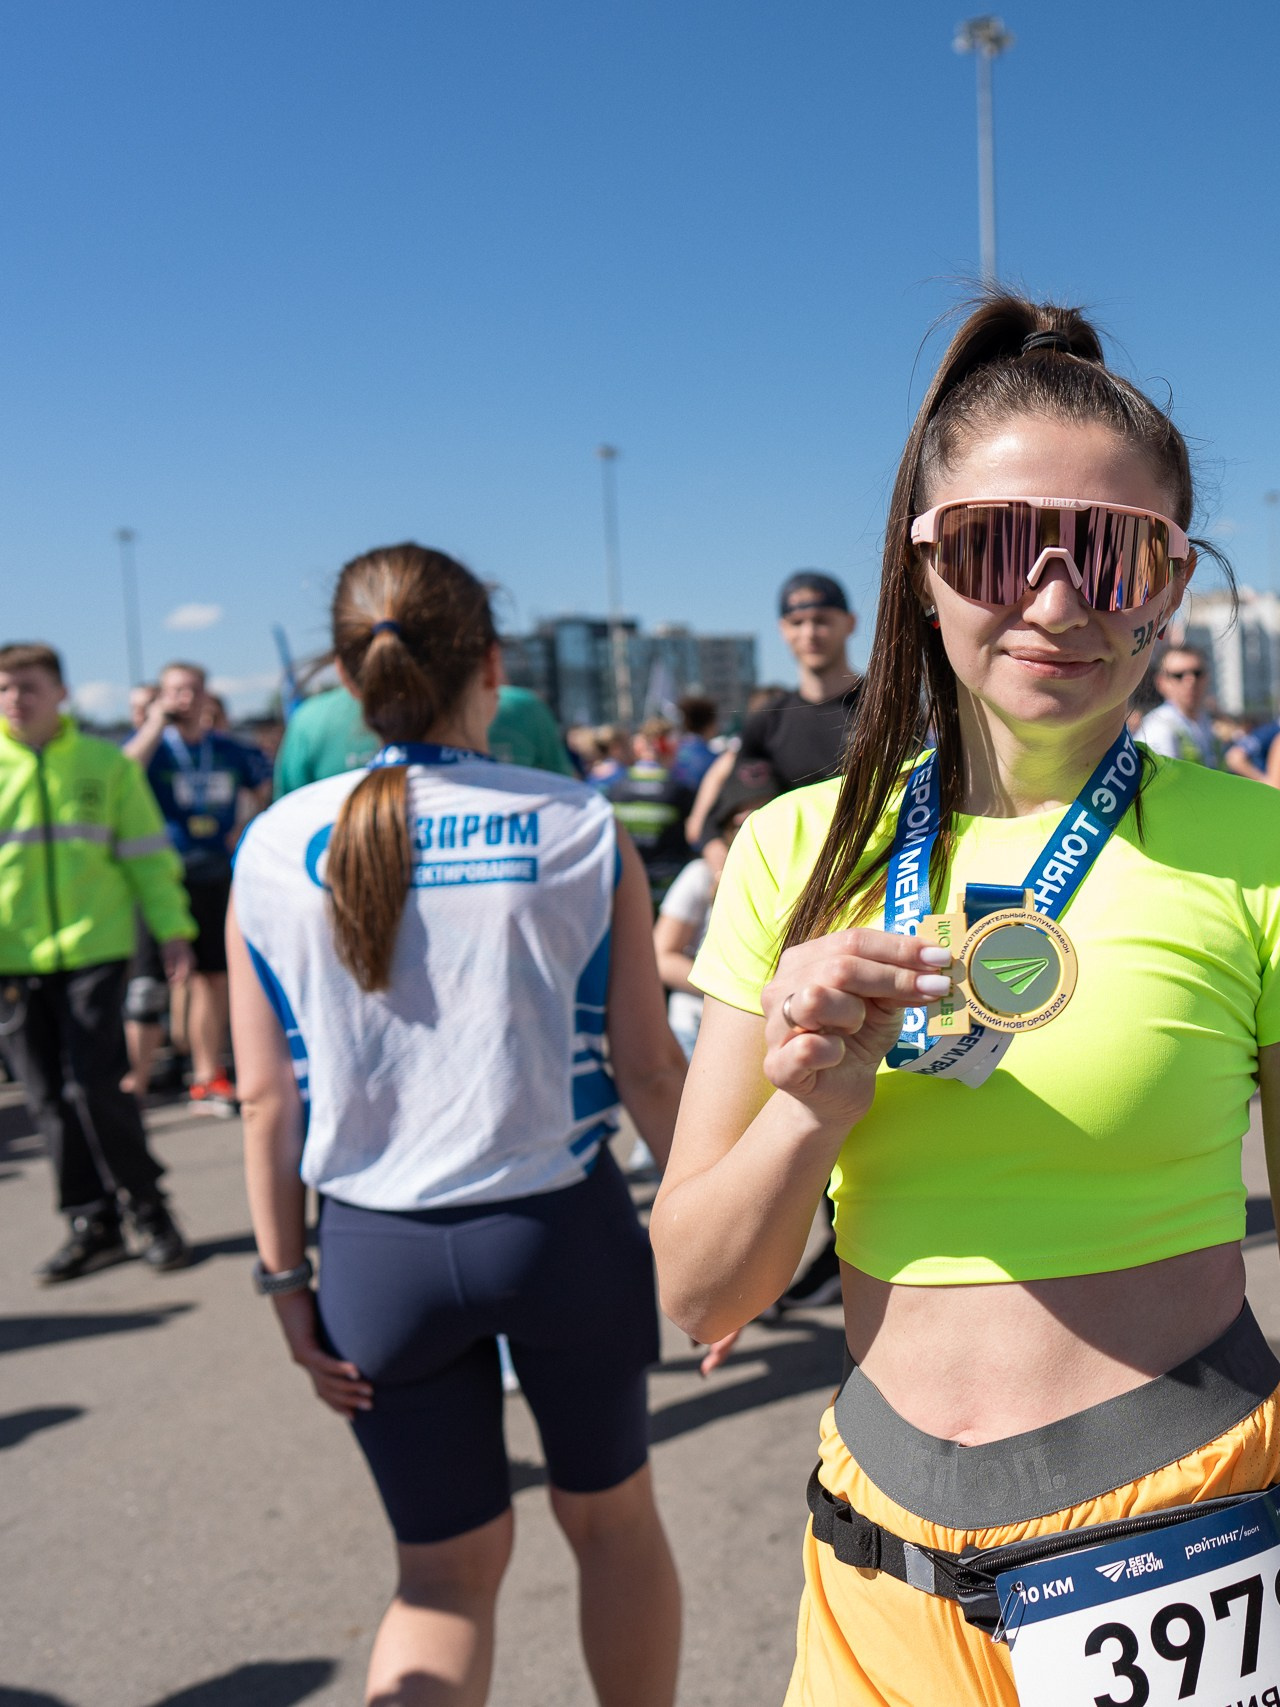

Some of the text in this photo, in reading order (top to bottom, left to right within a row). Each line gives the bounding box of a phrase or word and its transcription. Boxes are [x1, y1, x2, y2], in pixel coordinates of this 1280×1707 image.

[1091, 734, 1138, 813] ЭТОТ
[415, 812, 538, 850] ЗПРОМ
[416, 860, 533, 884] ЕКТИРОВАНИЕ
[895, 847, 922, 937] МЕНЯ
[960, 912, 1070, 960] БЛАГОТВОРИТЕЛЬНЫЙ ПОЛУМАРАФОН
[966, 993, 1067, 1029] НИЖНИЙ НОВГОРОД 2024
[1019, 1586, 1040, 1605] 10
